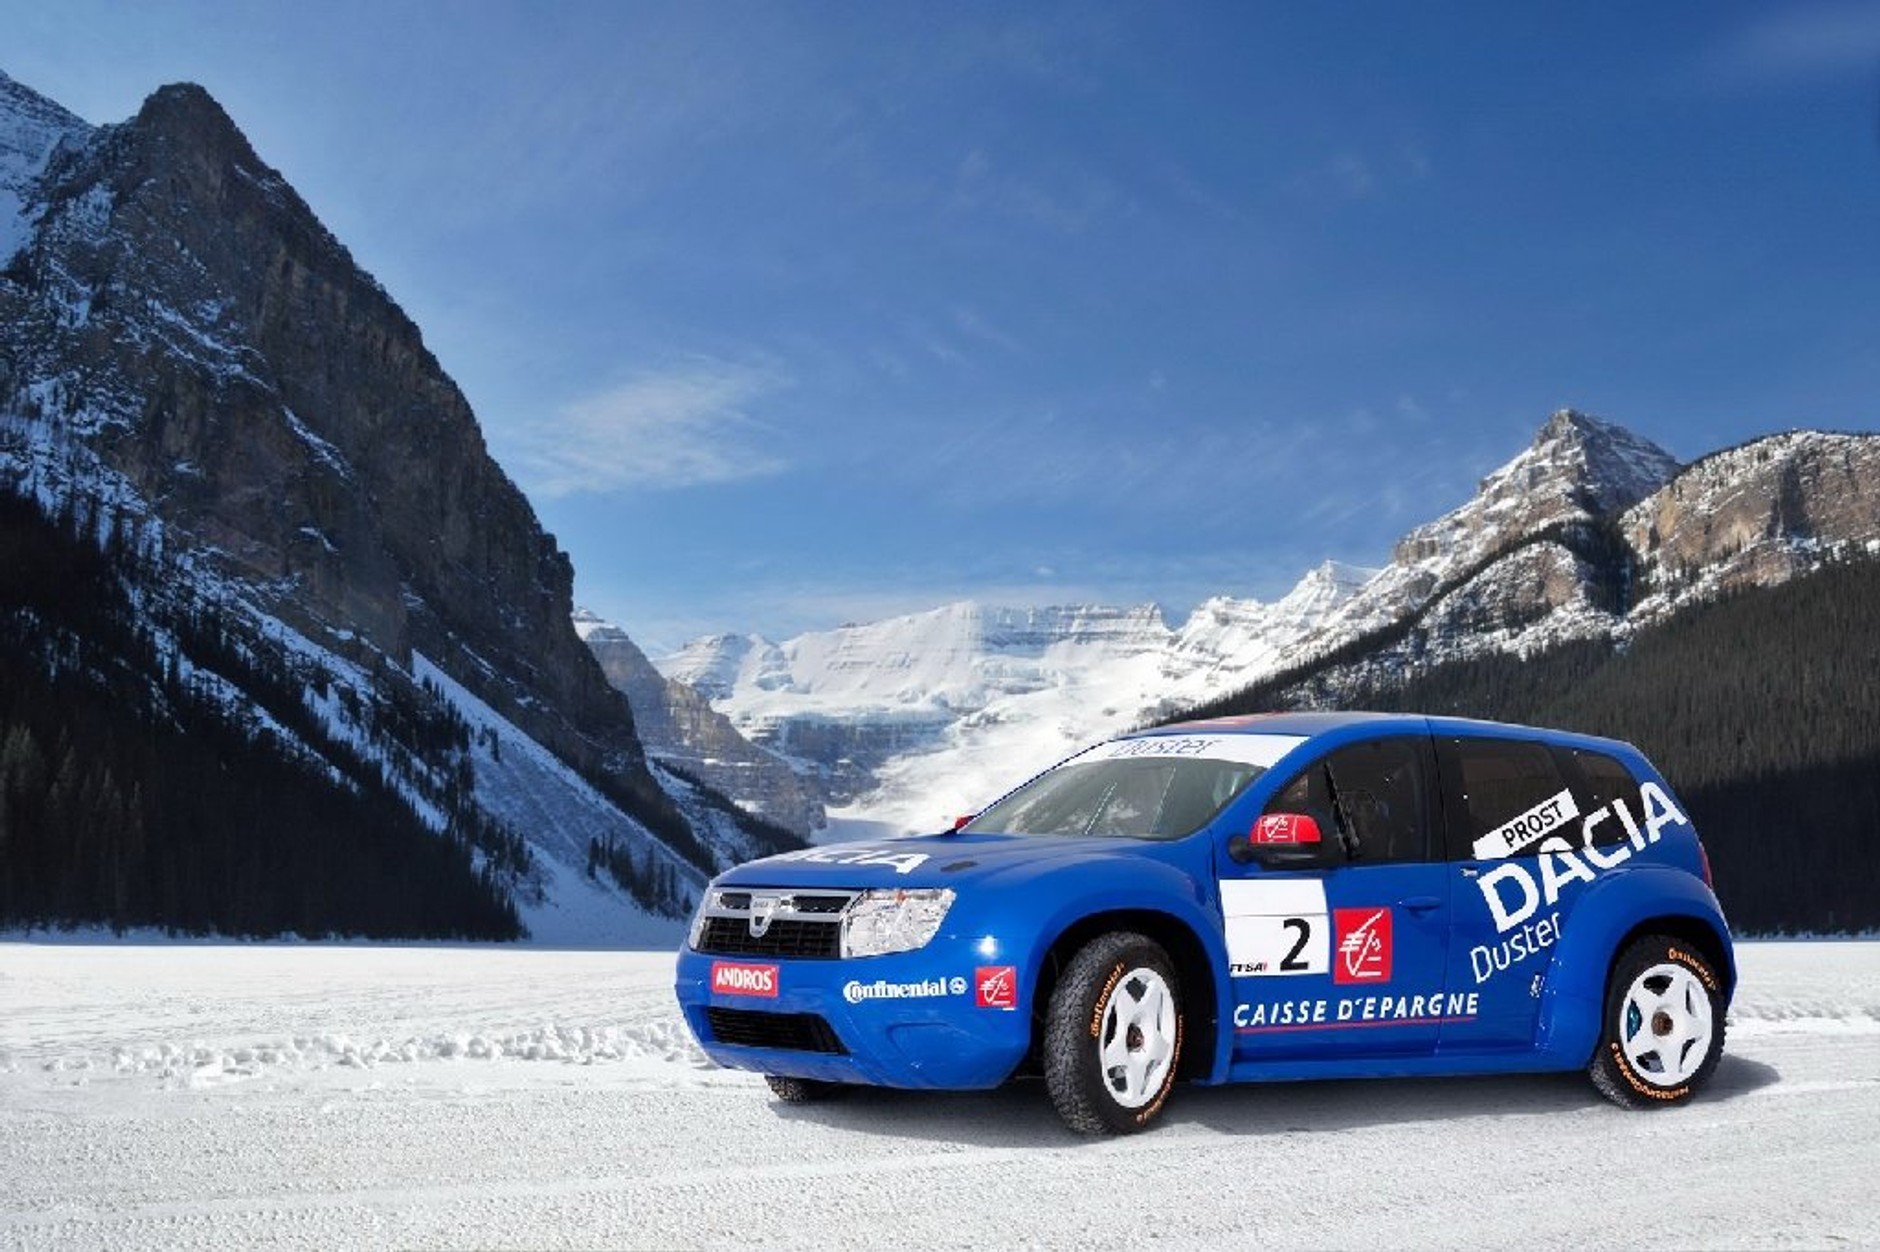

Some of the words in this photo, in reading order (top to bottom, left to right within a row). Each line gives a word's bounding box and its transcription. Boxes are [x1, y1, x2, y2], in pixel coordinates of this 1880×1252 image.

[1501, 800, 1565, 847] PROST
[1476, 782, 1688, 933] DACIA
[1280, 918, 1311, 971] 2
[1470, 912, 1560, 983] Duster
[716, 967, 772, 991] ANDROS
[843, 977, 947, 1004] Continental
[1233, 1000, 1327, 1027] CAISSE
